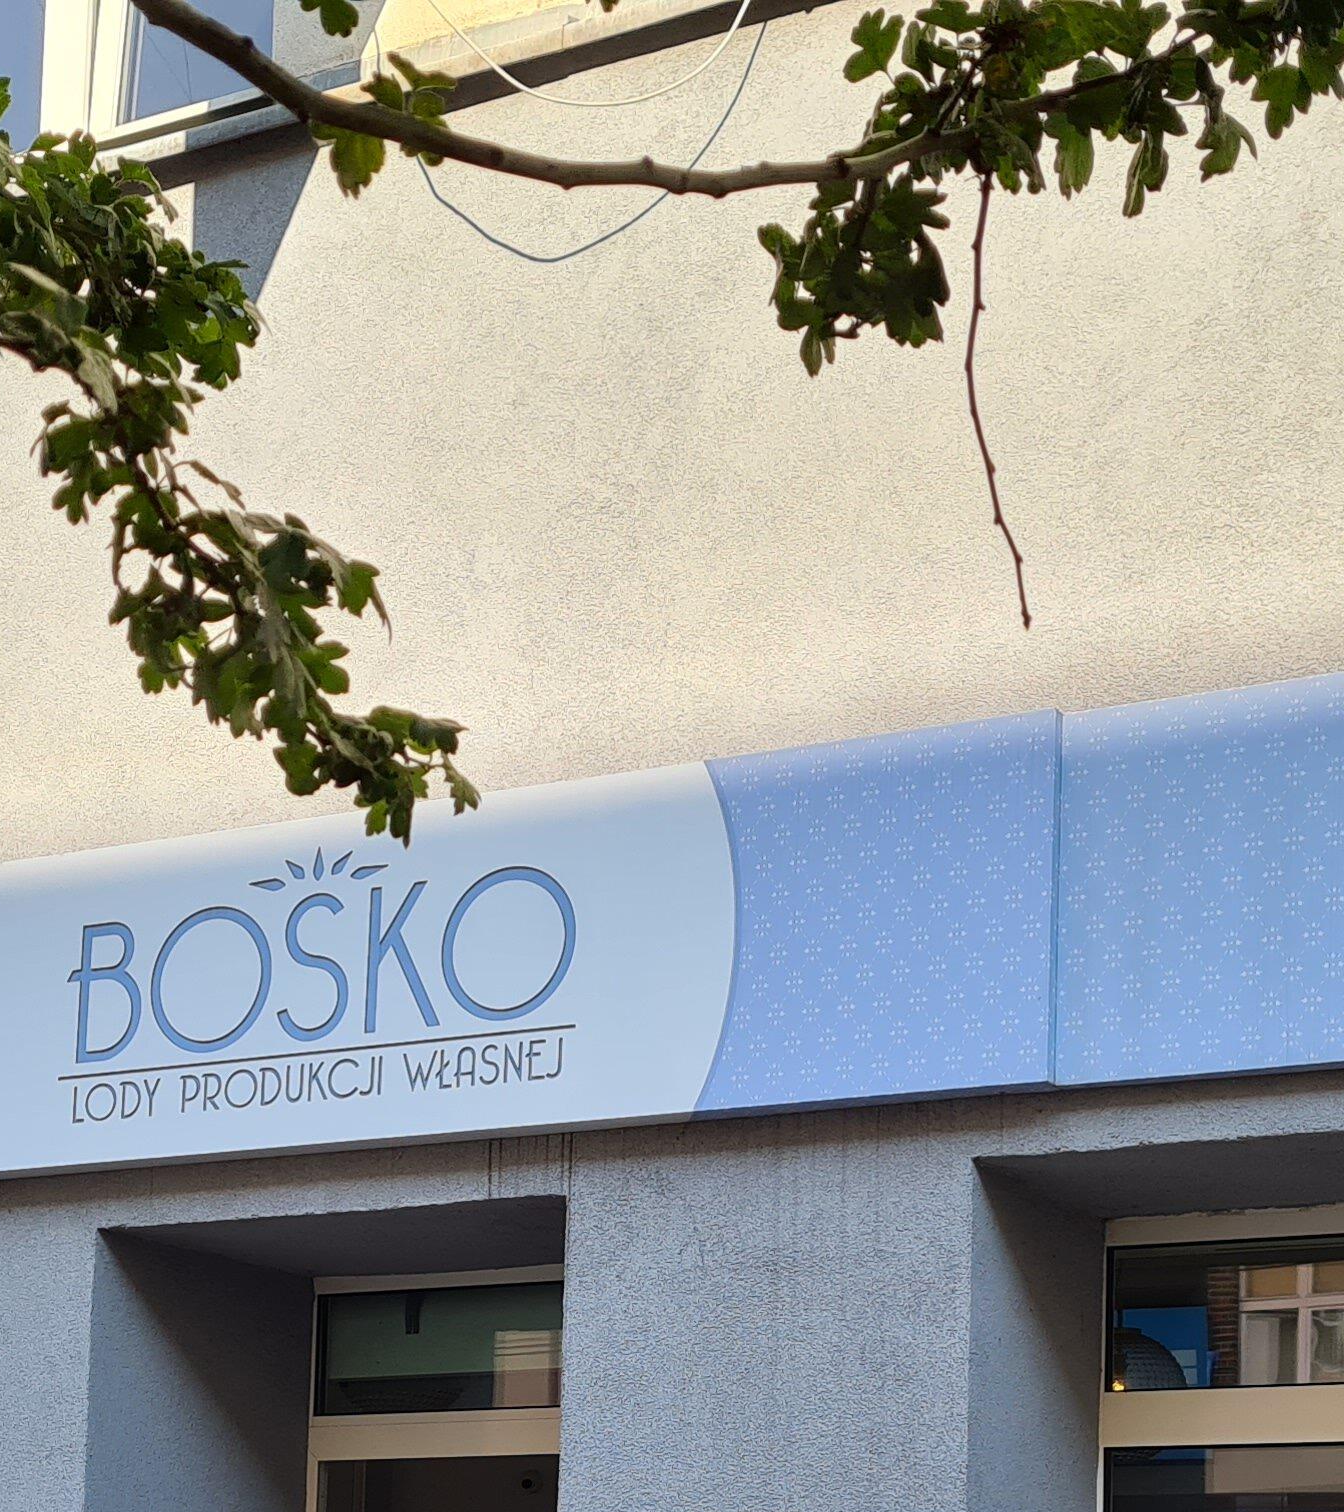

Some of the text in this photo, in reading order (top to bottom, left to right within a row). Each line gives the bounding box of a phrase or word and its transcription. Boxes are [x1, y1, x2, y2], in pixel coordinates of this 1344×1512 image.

[71, 1037, 565, 1124] LODY PRODUKCJI WŁASNEJ
